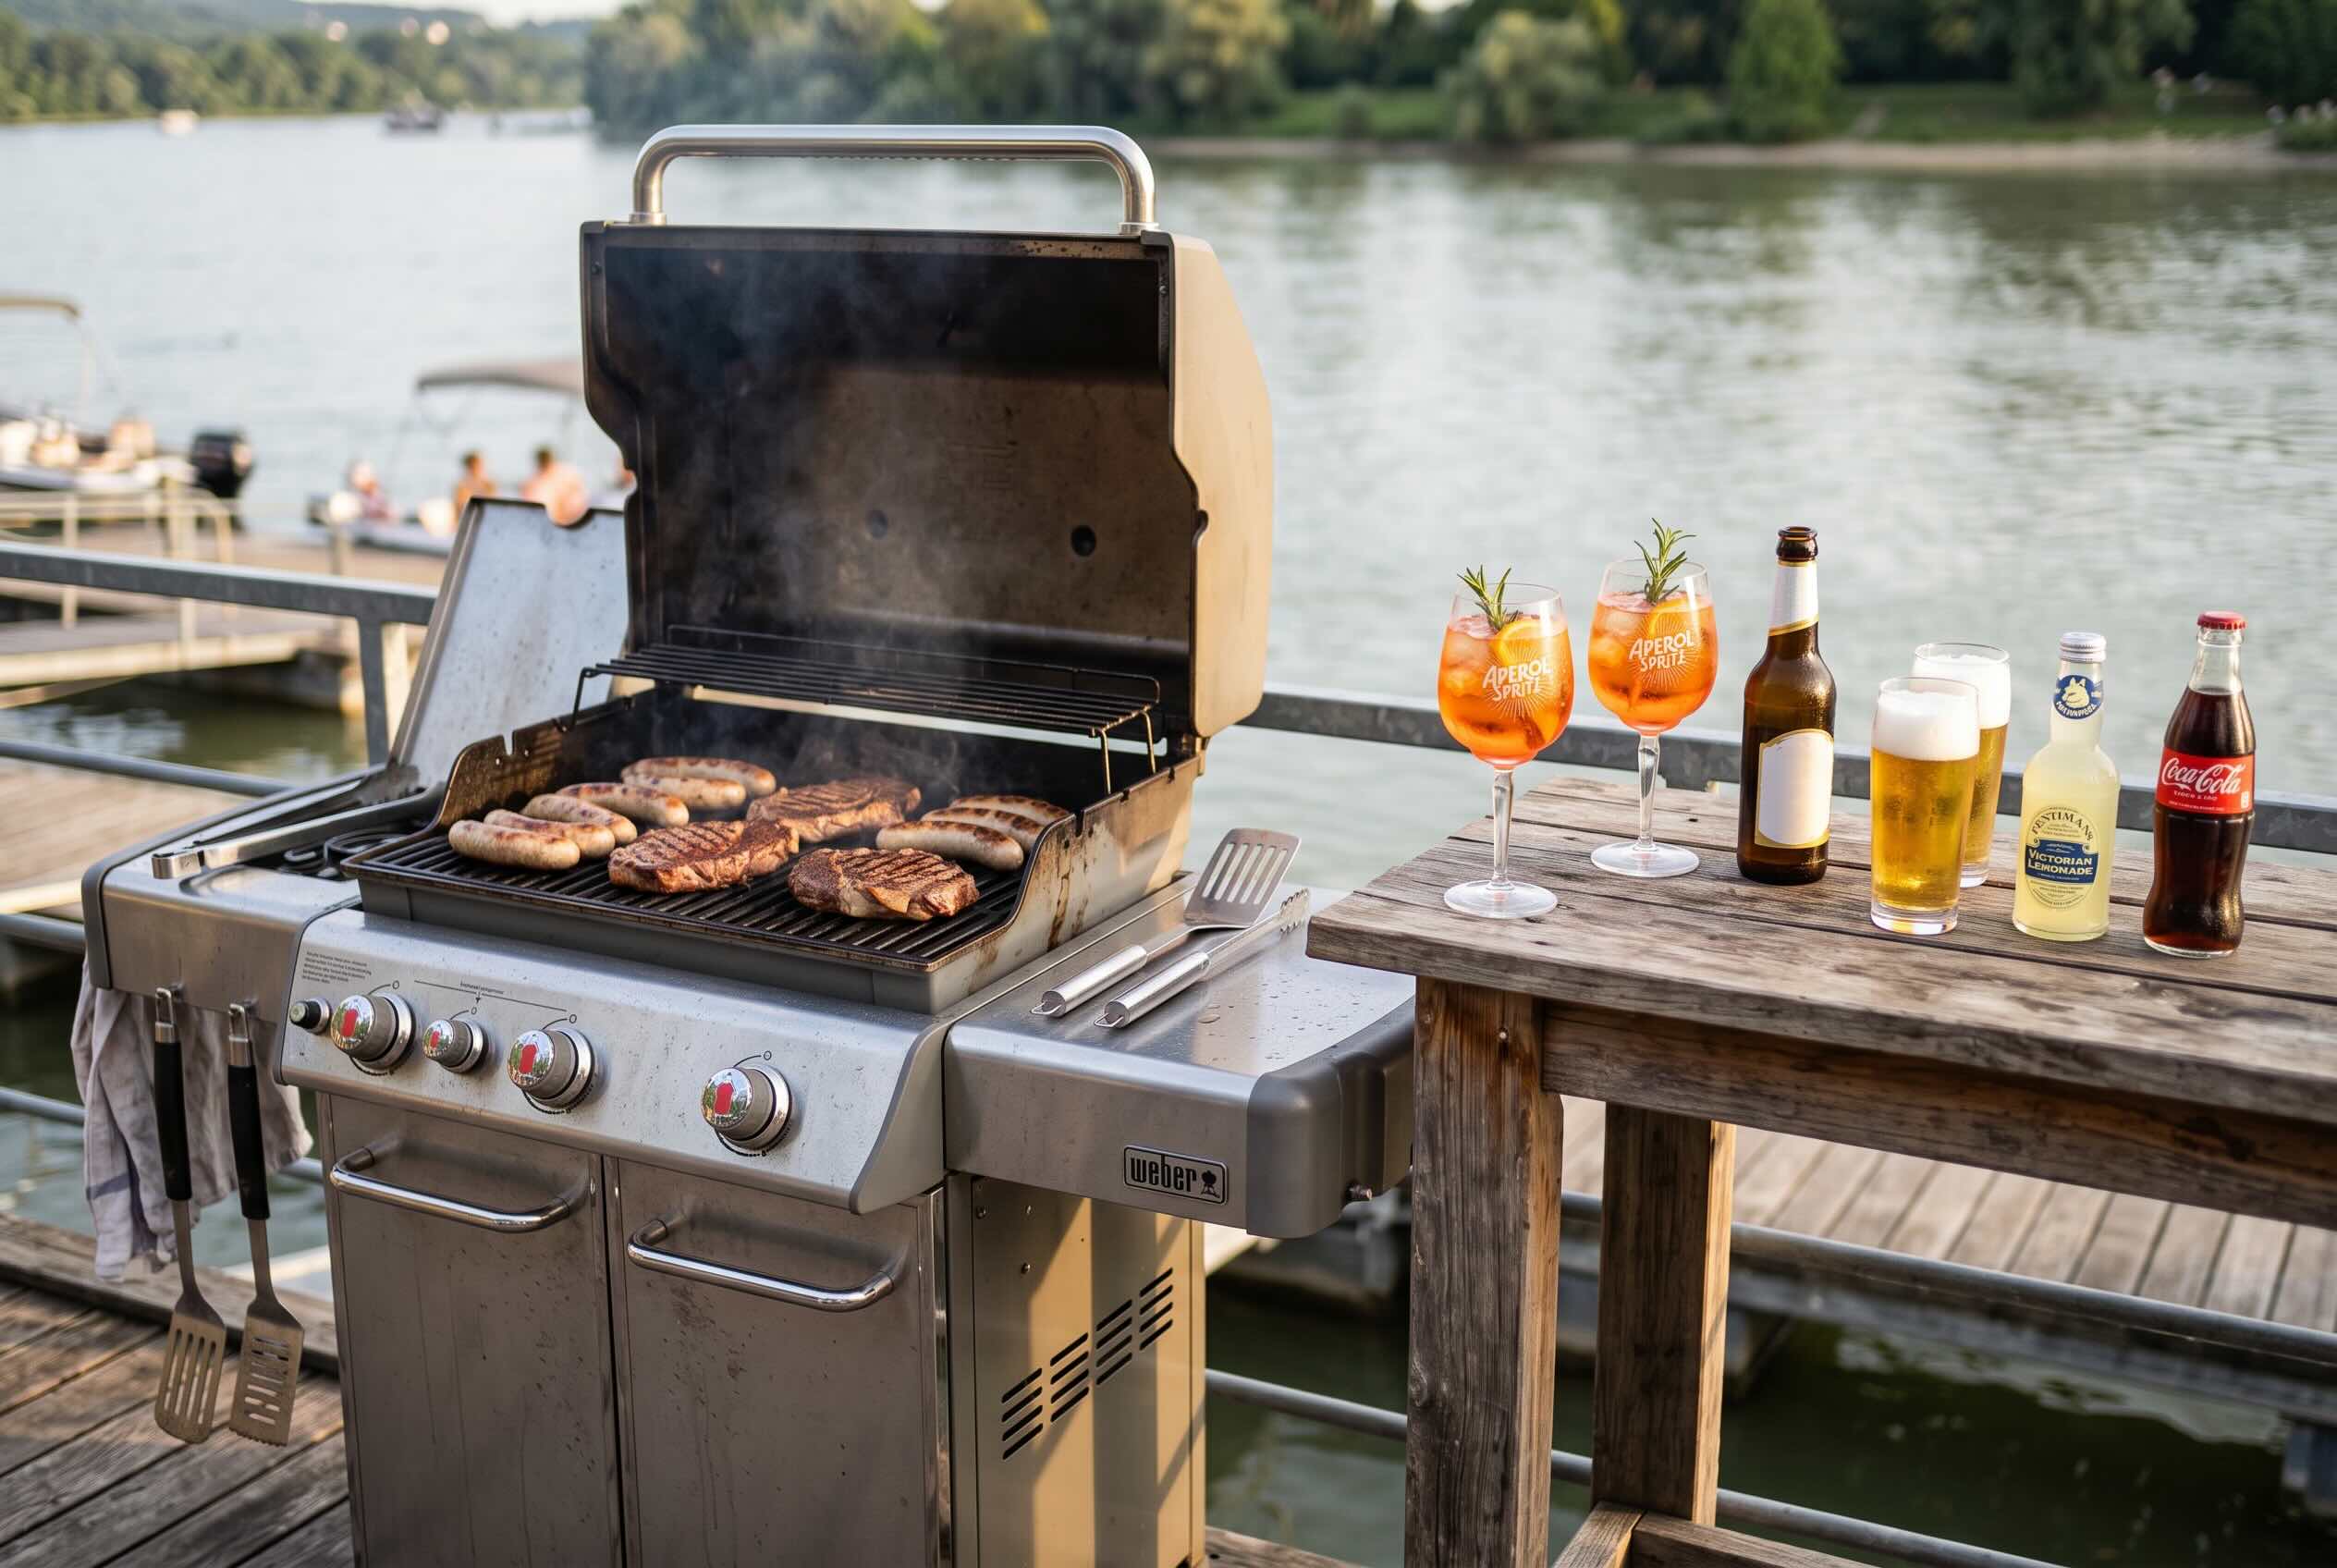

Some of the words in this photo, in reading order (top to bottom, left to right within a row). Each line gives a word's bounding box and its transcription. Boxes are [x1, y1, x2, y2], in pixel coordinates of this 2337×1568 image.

[1628, 629, 1695, 661] APEROL
[1482, 656, 1554, 690] APEROL
[2161, 757, 2245, 794] Coca-Cola
[2027, 849, 2094, 866] VICTORIAN
[2027, 859, 2095, 876] LEMONADE
[1130, 1155, 1198, 1193] weber
